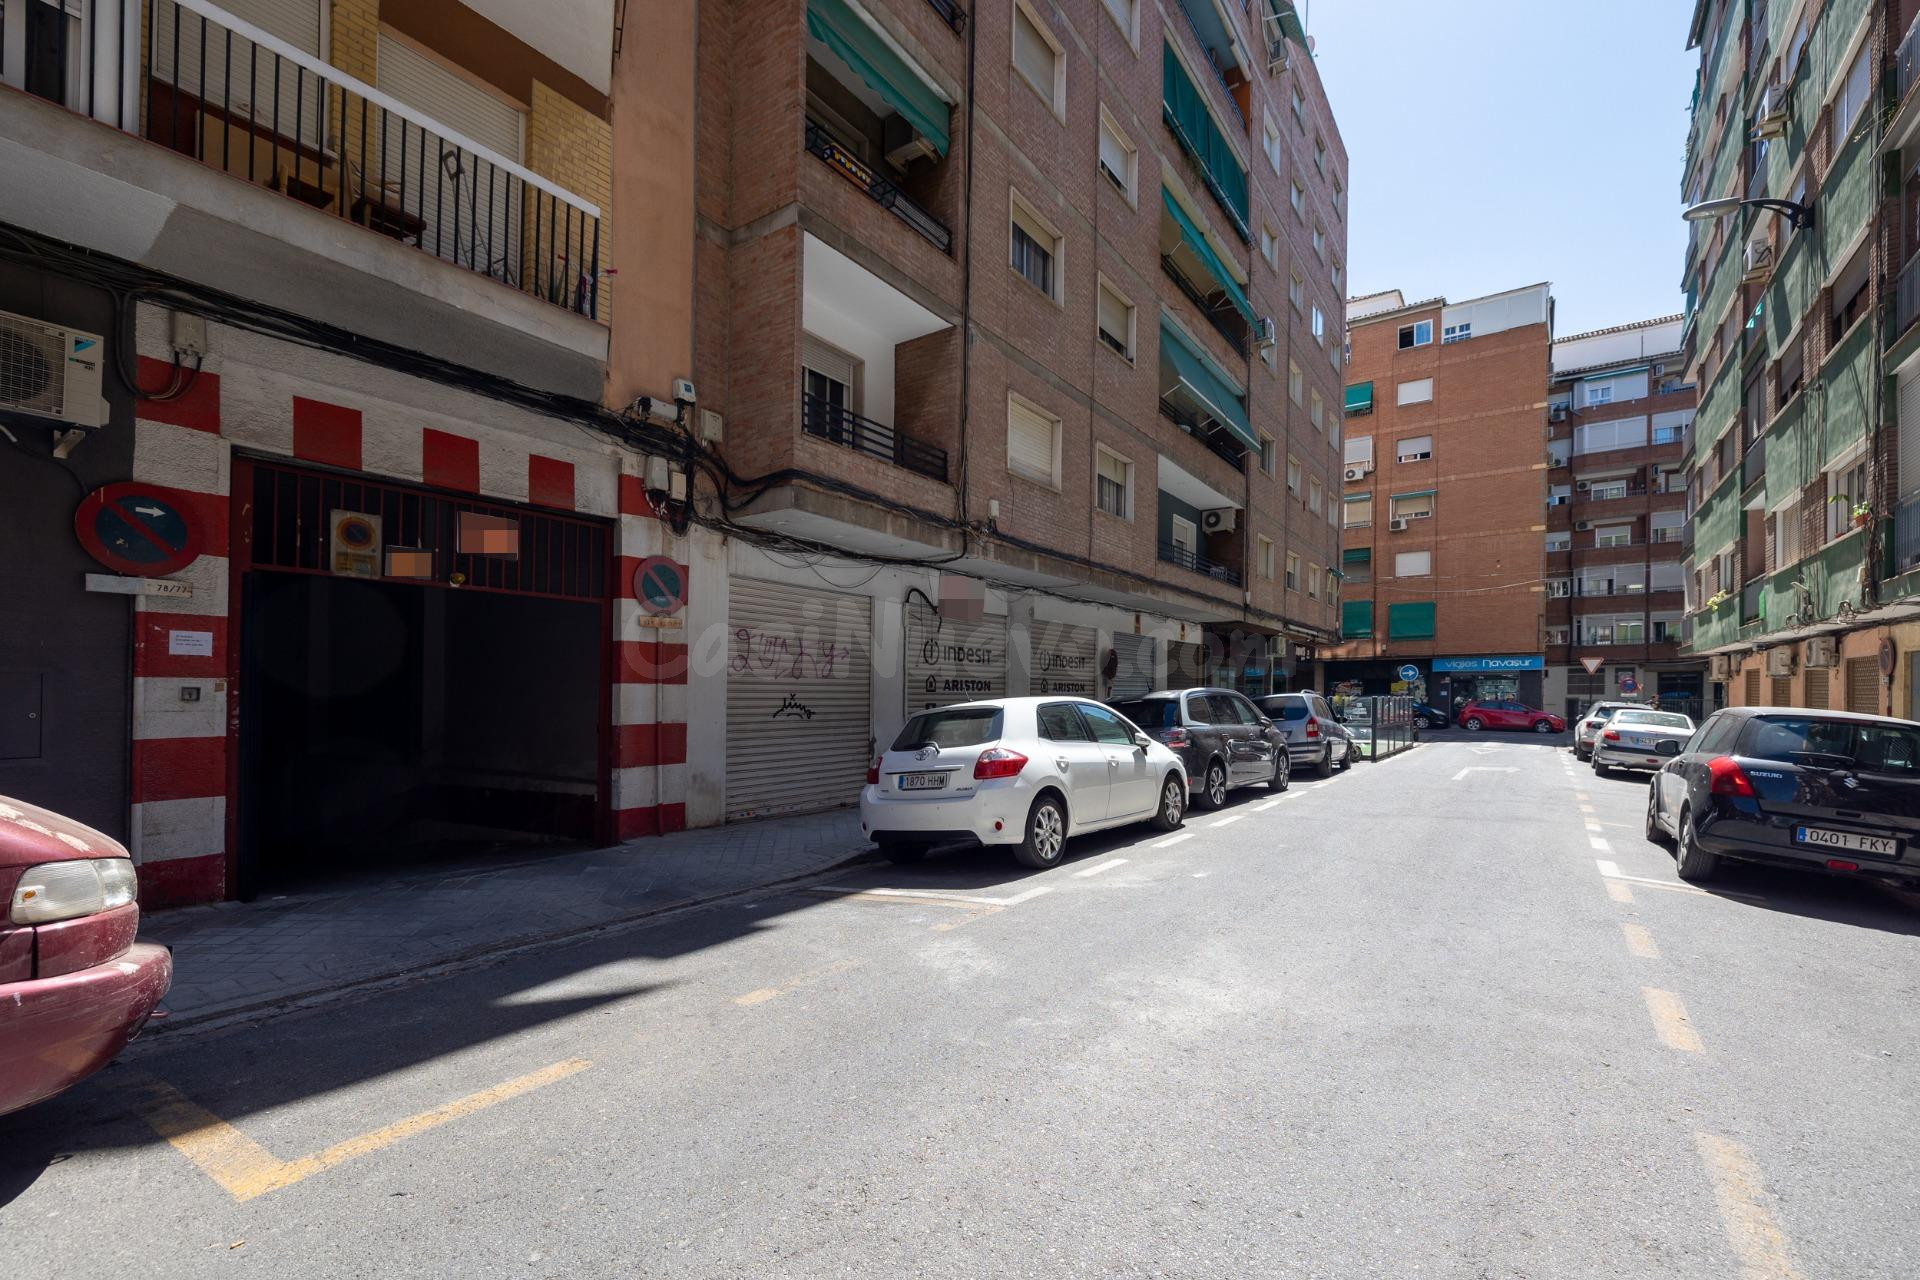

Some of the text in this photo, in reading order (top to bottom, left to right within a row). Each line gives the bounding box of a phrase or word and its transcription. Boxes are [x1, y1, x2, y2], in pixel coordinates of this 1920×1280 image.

[1445, 660, 1478, 669] viajes
[943, 679, 991, 692] ARISTON
[1052, 682, 1085, 692] ARISTON
[905, 775, 945, 786] 1870 HHM
[1809, 831, 1848, 846] 0401
[1859, 837, 1890, 851] FKY
